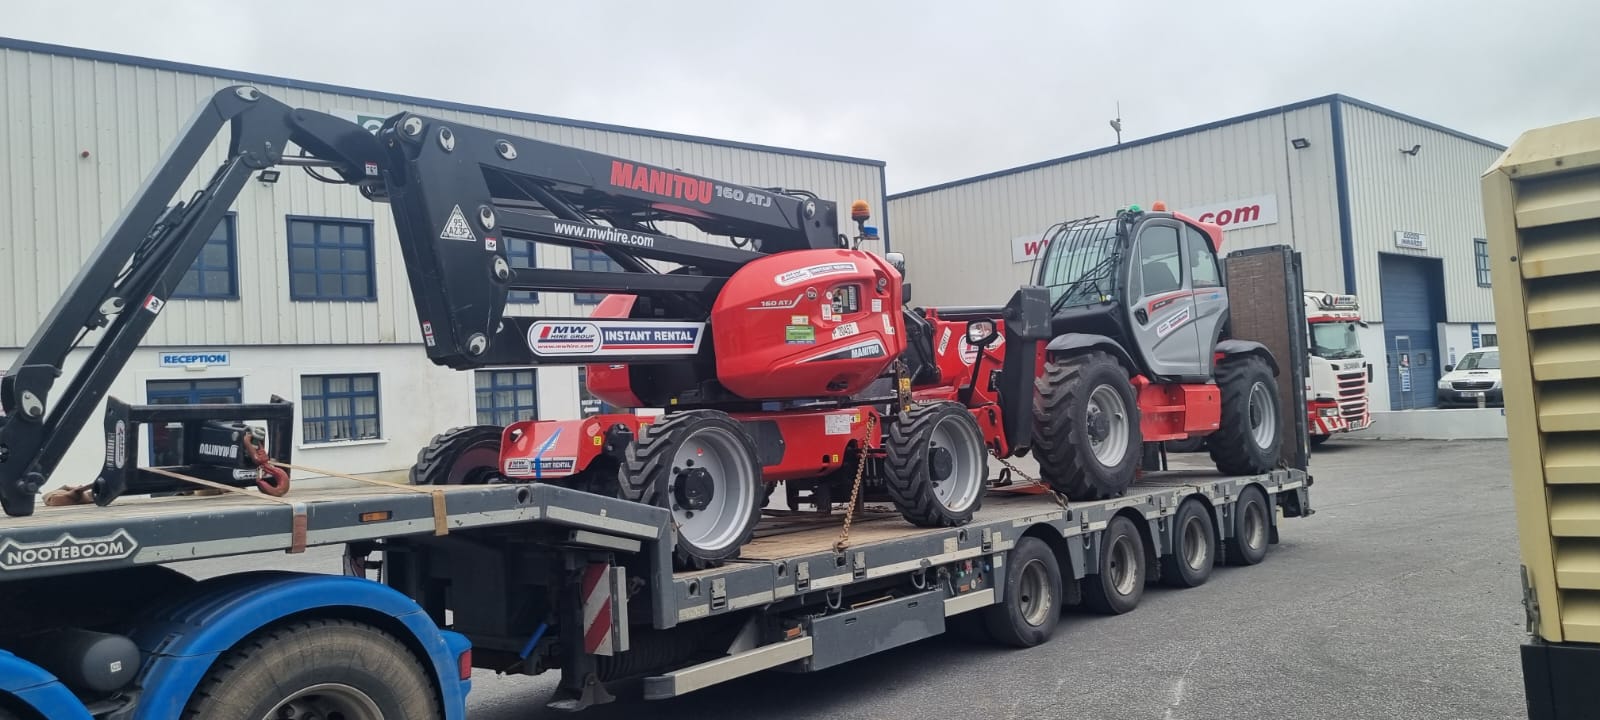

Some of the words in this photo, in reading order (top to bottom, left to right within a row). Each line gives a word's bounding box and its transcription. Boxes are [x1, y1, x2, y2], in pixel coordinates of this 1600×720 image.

[610, 160, 713, 205] MANITOU
[715, 184, 744, 201] 160
[745, 192, 772, 208] ATJ
[553, 222, 654, 247] www.mwhire.com
[552, 326, 587, 334] MW
[605, 330, 651, 341] INSTANT
[654, 330, 694, 341] RENTAL
[163, 354, 227, 364] RECEPTION
[851, 344, 880, 359] MANITOU
[199, 443, 231, 458] MANITOU
[7, 541, 124, 565] NOOTEBOOM
